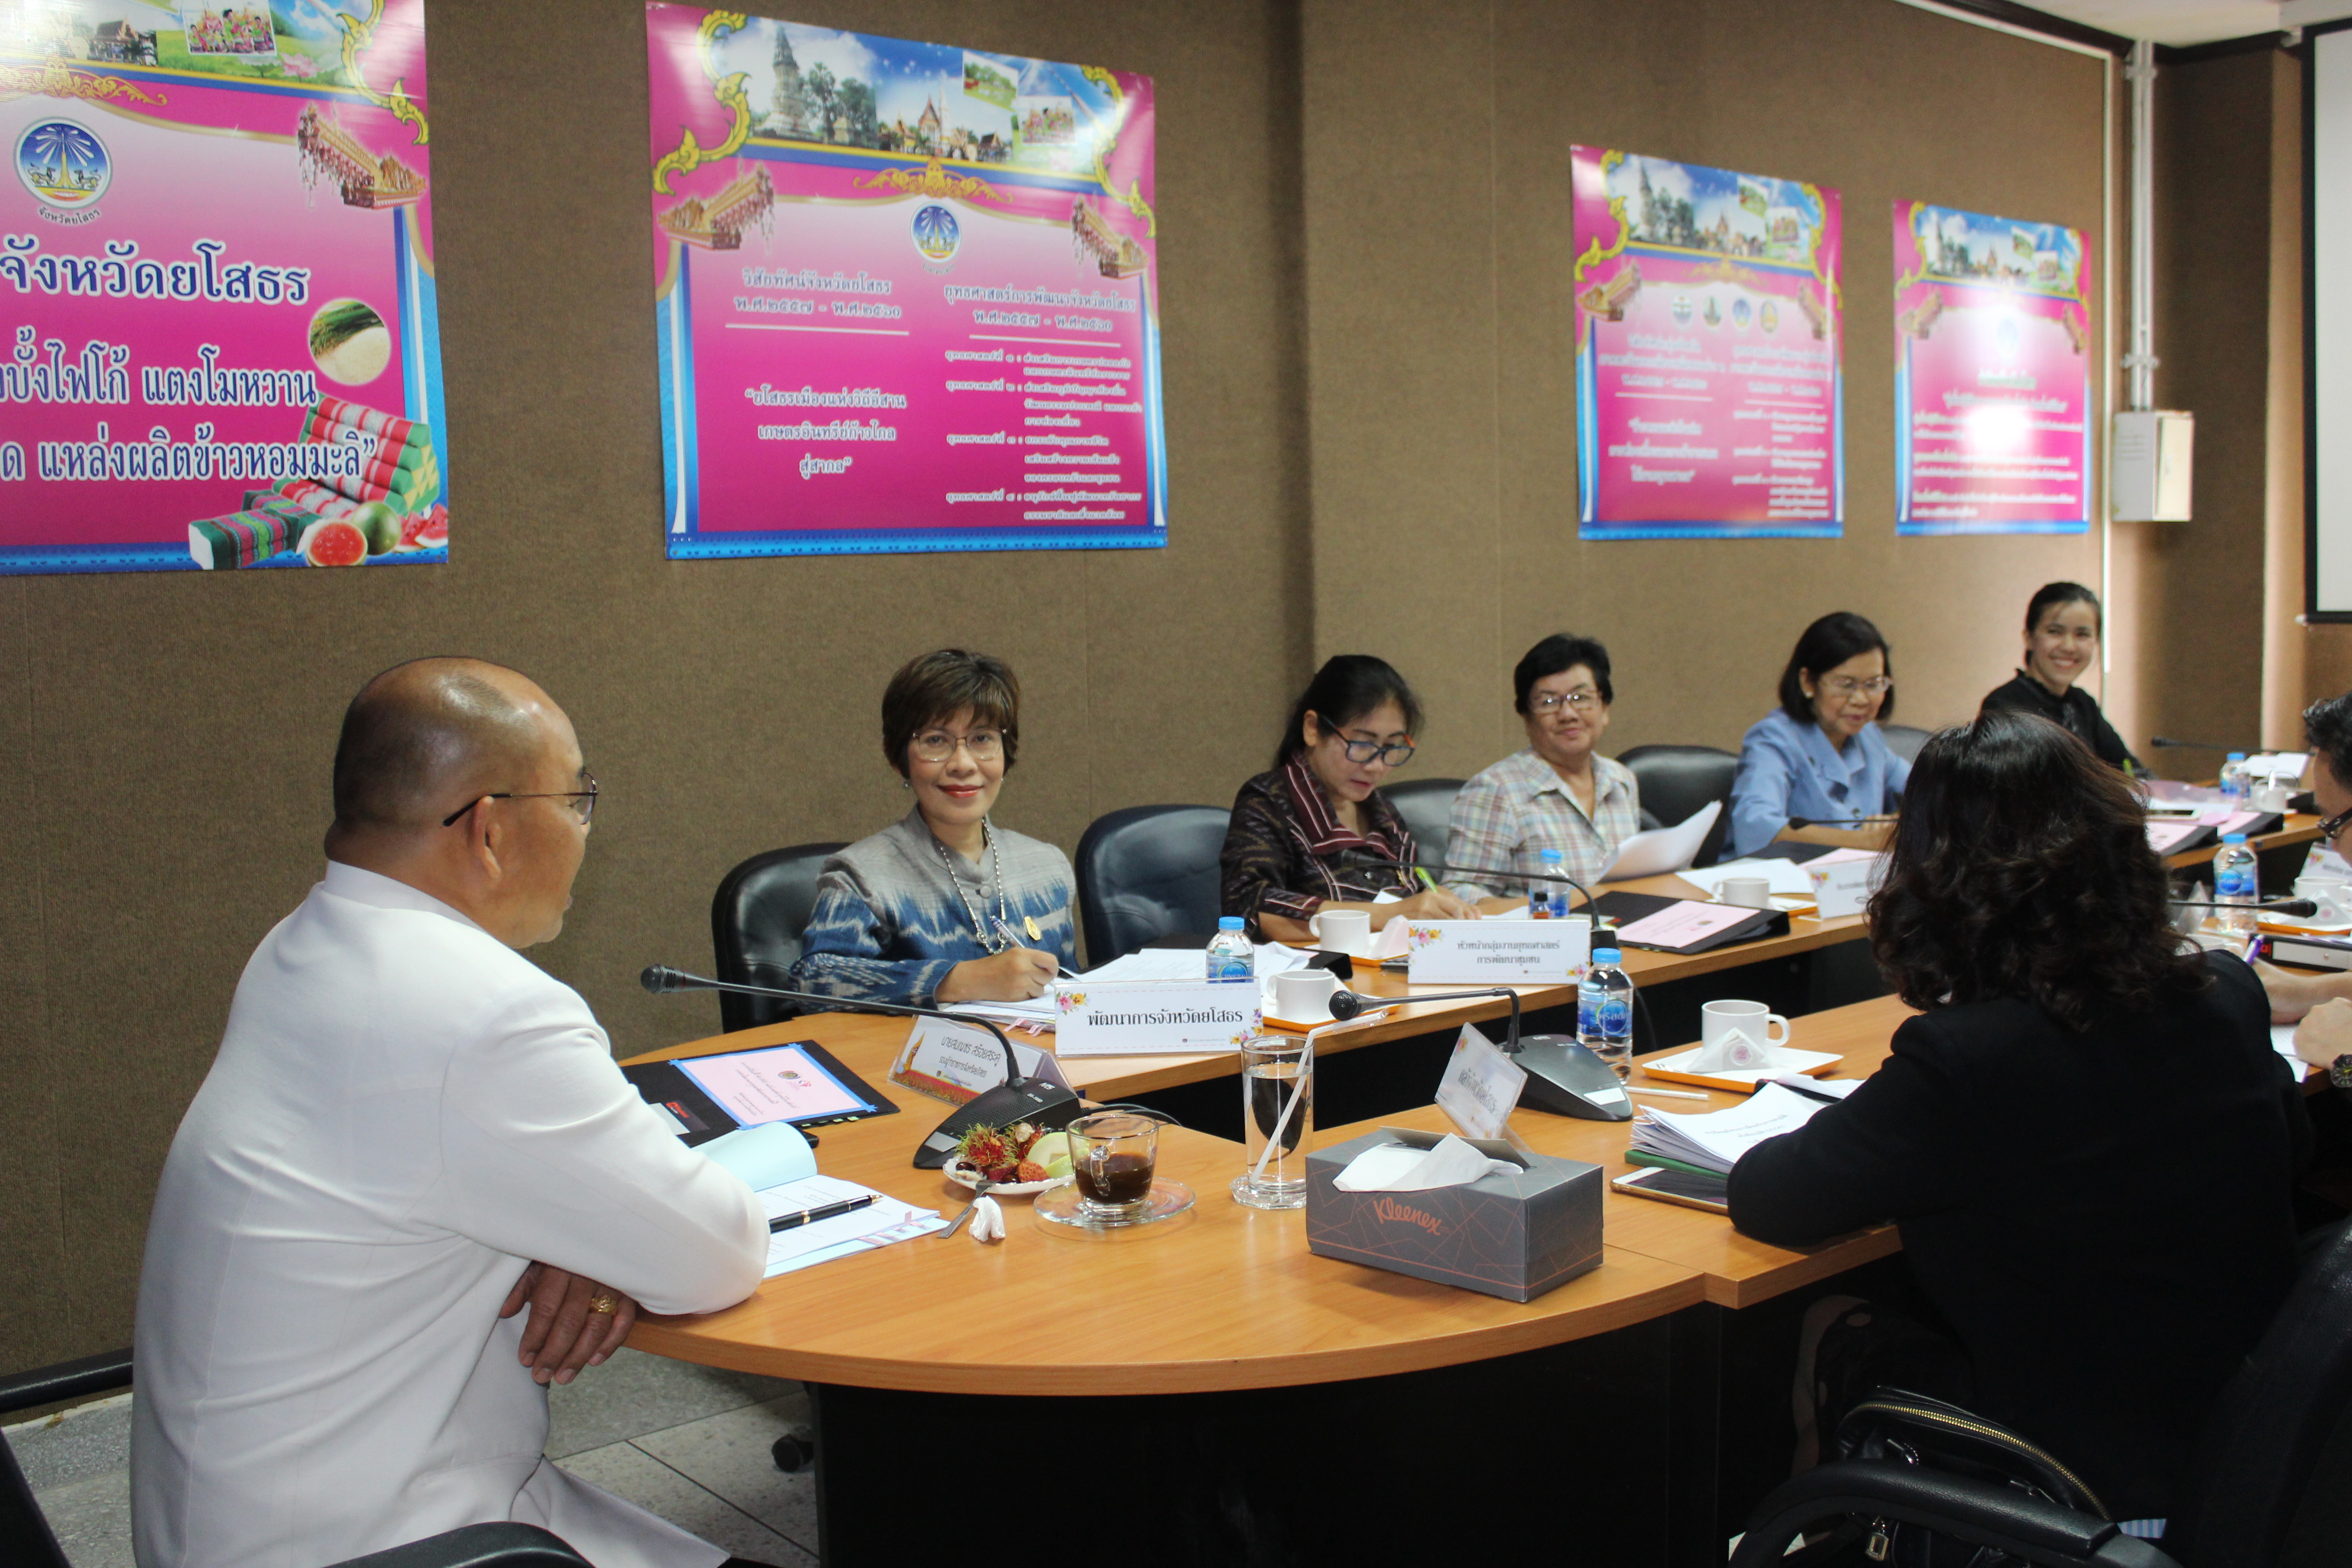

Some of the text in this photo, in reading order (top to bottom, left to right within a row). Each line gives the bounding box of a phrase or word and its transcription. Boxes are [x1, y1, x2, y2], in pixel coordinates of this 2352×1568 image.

[0, 236, 309, 304] จังหวัดยโสธร
[743, 268, 891, 294] วิสัยทัศน์จังหวัดยโสธร
[0, 327, 316, 404] บั้งไฟโก้ แตงโมหวาน
[745, 384, 906, 408] “ยโสธรเมืองแห่งวิถีอีสาน
[758, 419, 897, 440] เกษตรอินทรีย์ก้าวไกล
[41, 423, 377, 480] แหล่งผลิตข้าวหอมมะลิ”
[799, 453, 853, 480] สู่สากล”
[1087, 1007, 1243, 1026] พัฒนาการจังหวัดยโสธร
[1373, 1197, 1442, 1235] Kleenex
